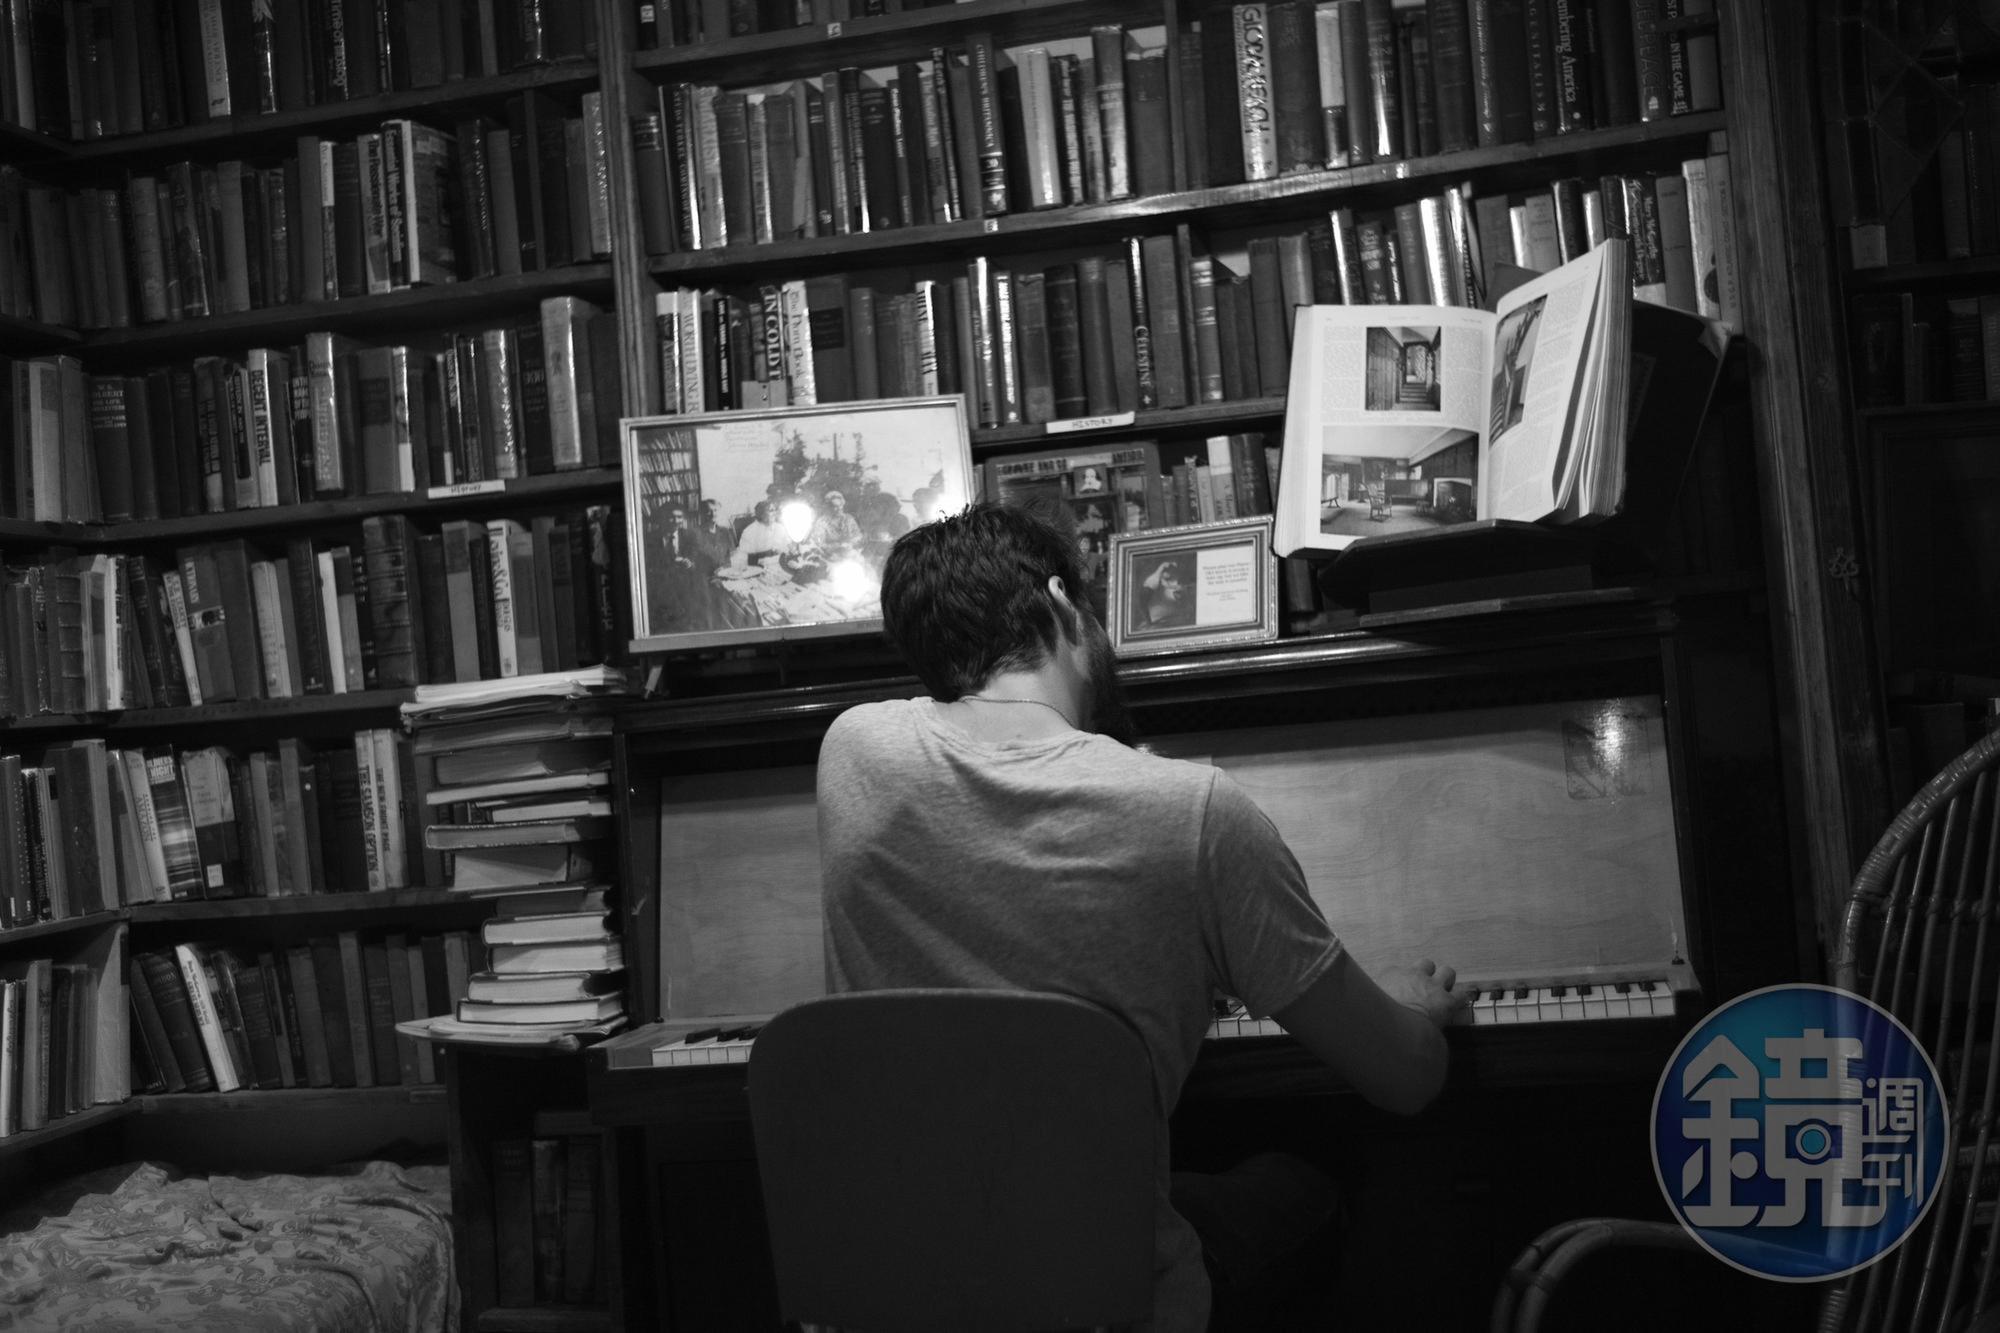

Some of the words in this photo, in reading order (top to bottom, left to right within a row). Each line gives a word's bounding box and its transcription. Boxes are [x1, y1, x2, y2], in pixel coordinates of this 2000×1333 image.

[1639, 33, 1662, 95] PEACE
[1670, 42, 1681, 53] IN
[1670, 54, 1682, 71] THE
[1561, 55, 1579, 103] America
[1672, 72, 1685, 99] GAME
[982, 97, 995, 148] BRITANNICA
[763, 292, 779, 313] IN
[683, 313, 699, 357] WORTH
[765, 314, 782, 367] COLD
[250, 369, 266, 412] DECENT
[686, 358, 700, 400] DYING
[254, 414, 270, 467] INTERVAL
[358, 764, 370, 786] THE
[361, 786, 375, 831] SAMSON
[379, 804, 389, 830] FRONT
[365, 833, 379, 872] OPTION
[381, 832, 391, 852] PAGE
